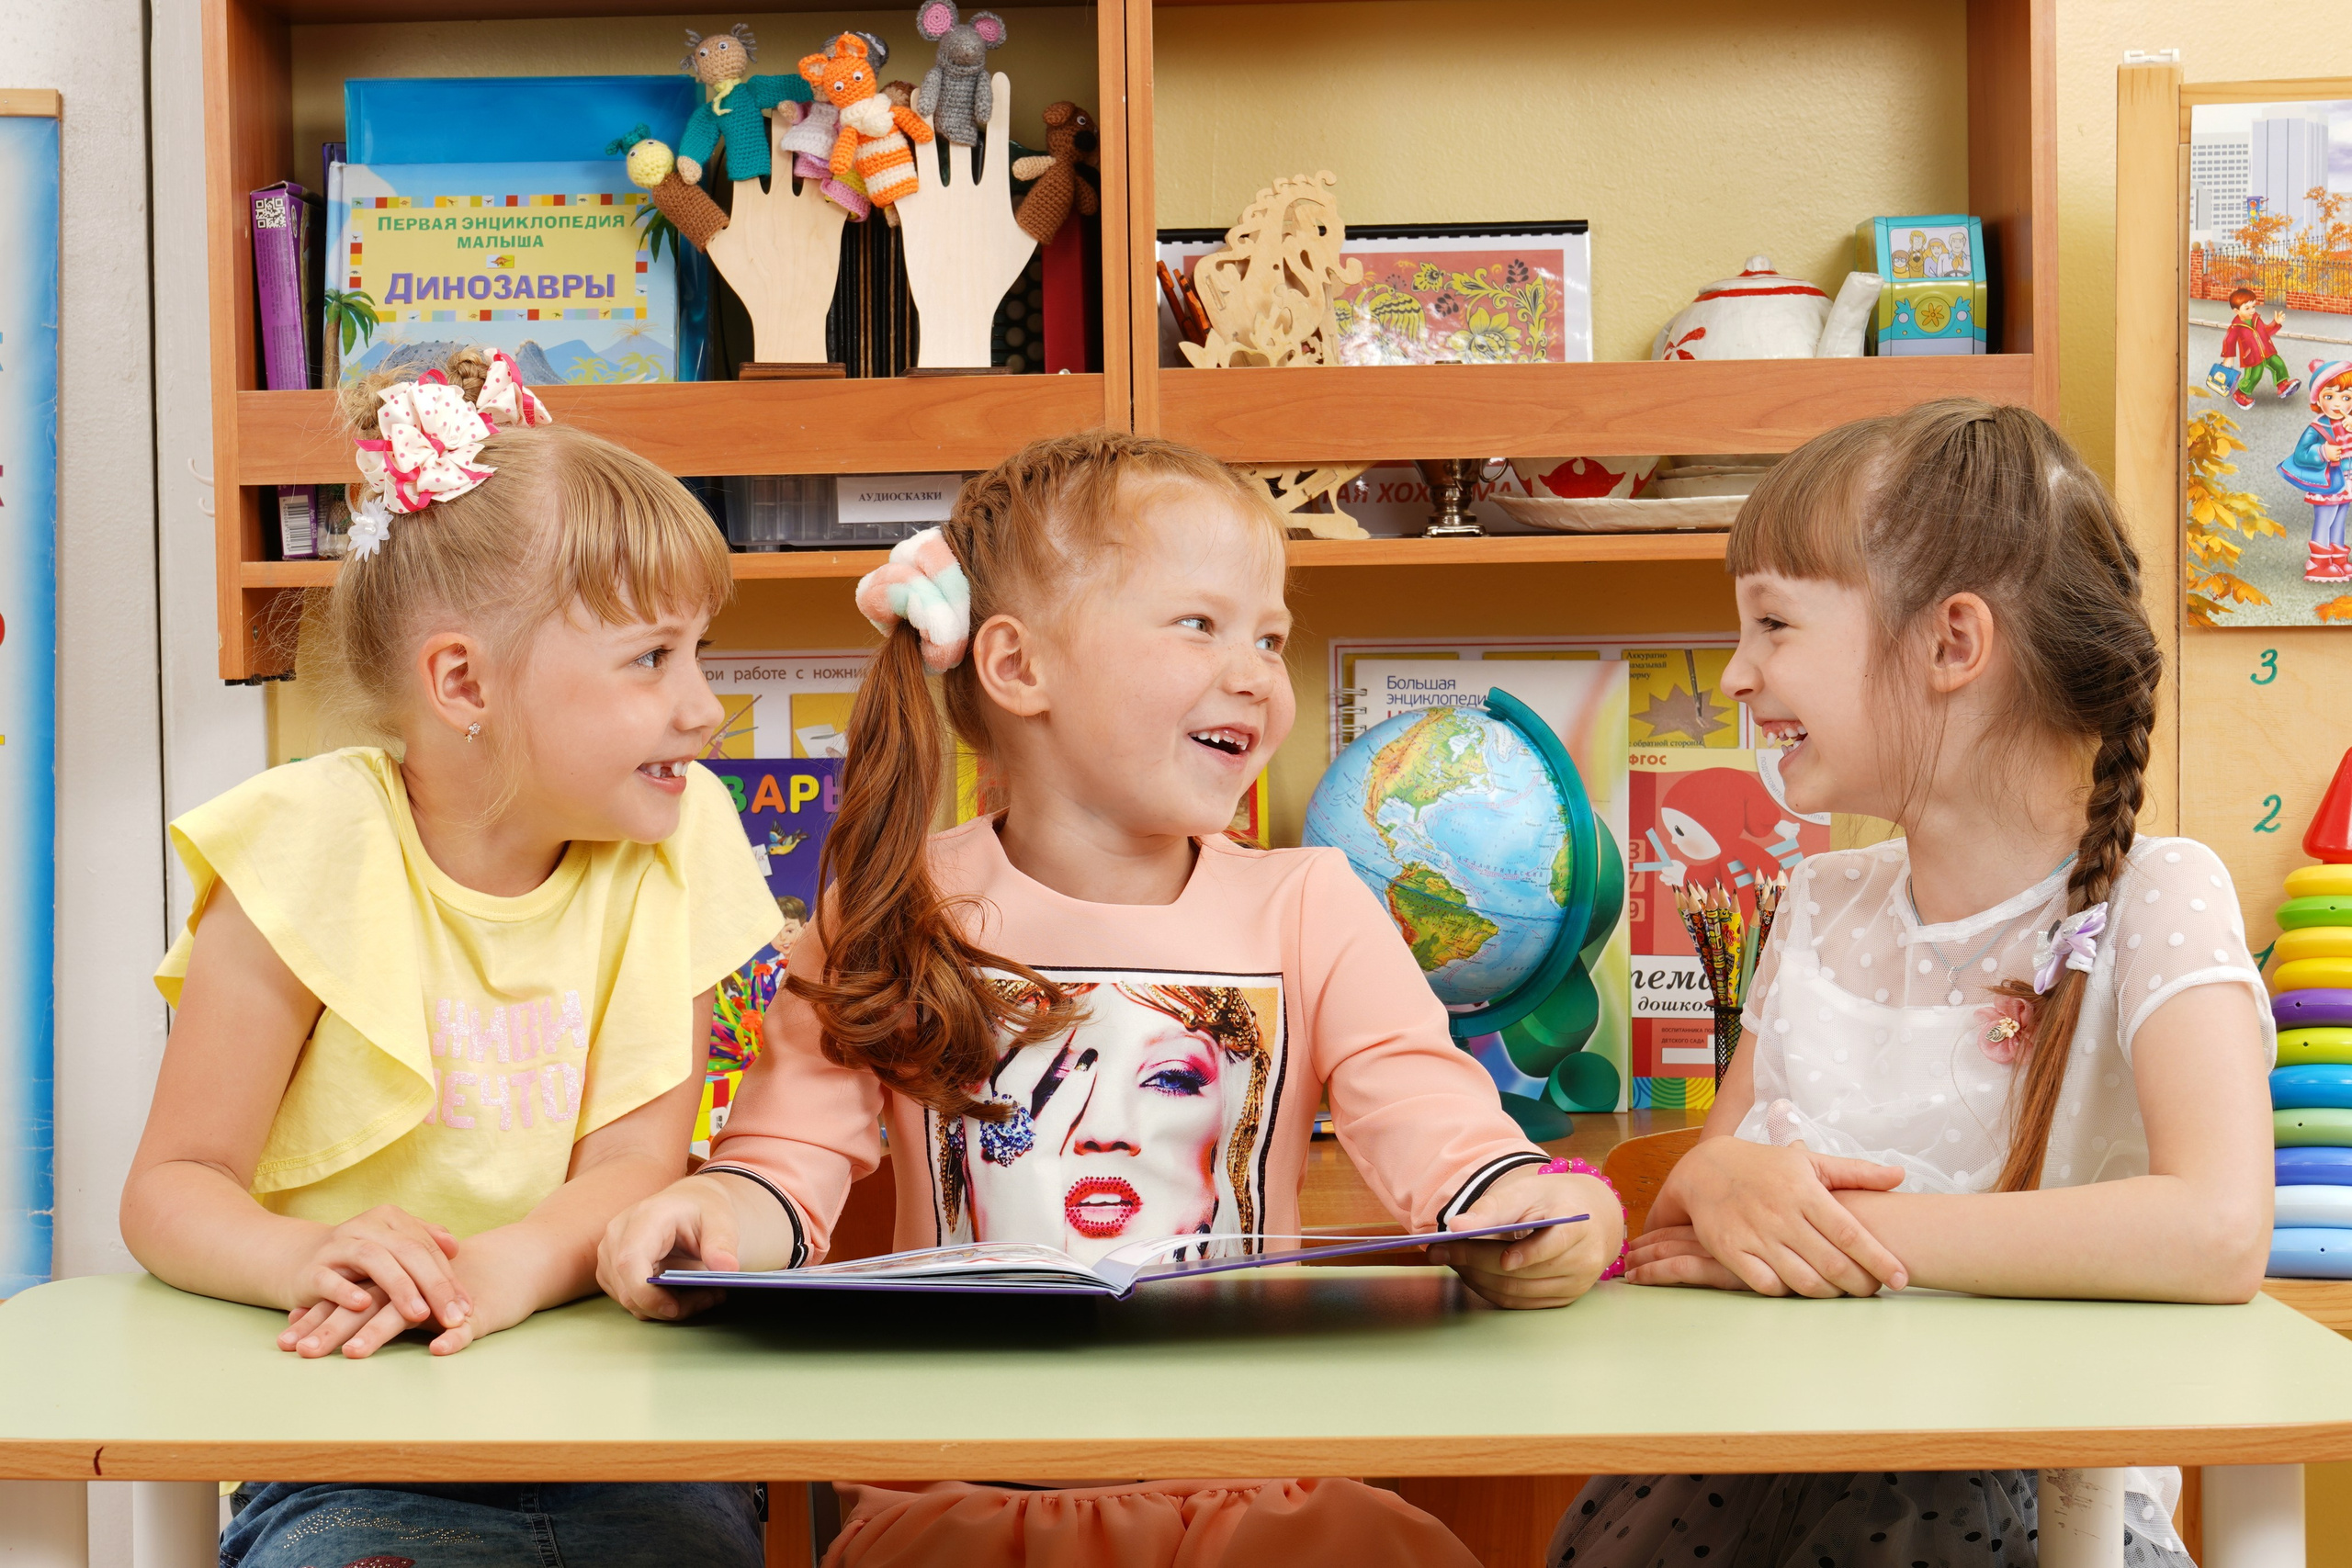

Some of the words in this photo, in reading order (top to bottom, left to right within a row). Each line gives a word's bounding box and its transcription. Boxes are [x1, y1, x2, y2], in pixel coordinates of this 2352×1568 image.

[378, 216, 457, 231] ПЕРВАЯ
[462, 215, 625, 231] ЭНЦИКЛОПЕДИЯ
[457, 235, 544, 249] МАЛЫША
[384, 273, 616, 304] ДИНОЗАВРЫ
[858, 491, 942, 502] АУДИОСКАЗКИ
[734, 666, 786, 683] работе
[796, 669, 804, 680] с
[2250, 649, 2278, 685] 3
[1386, 676, 1455, 690] Большая
[1386, 693, 1487, 706] энциклопеди
[1633, 739, 1668, 747] обратной
[1629, 753, 1667, 765] ФГОС
[2253, 794, 2282, 833] 2
[432, 989, 586, 1064] ЖИВИ
[423, 1058, 586, 1131] ЕЧТО
